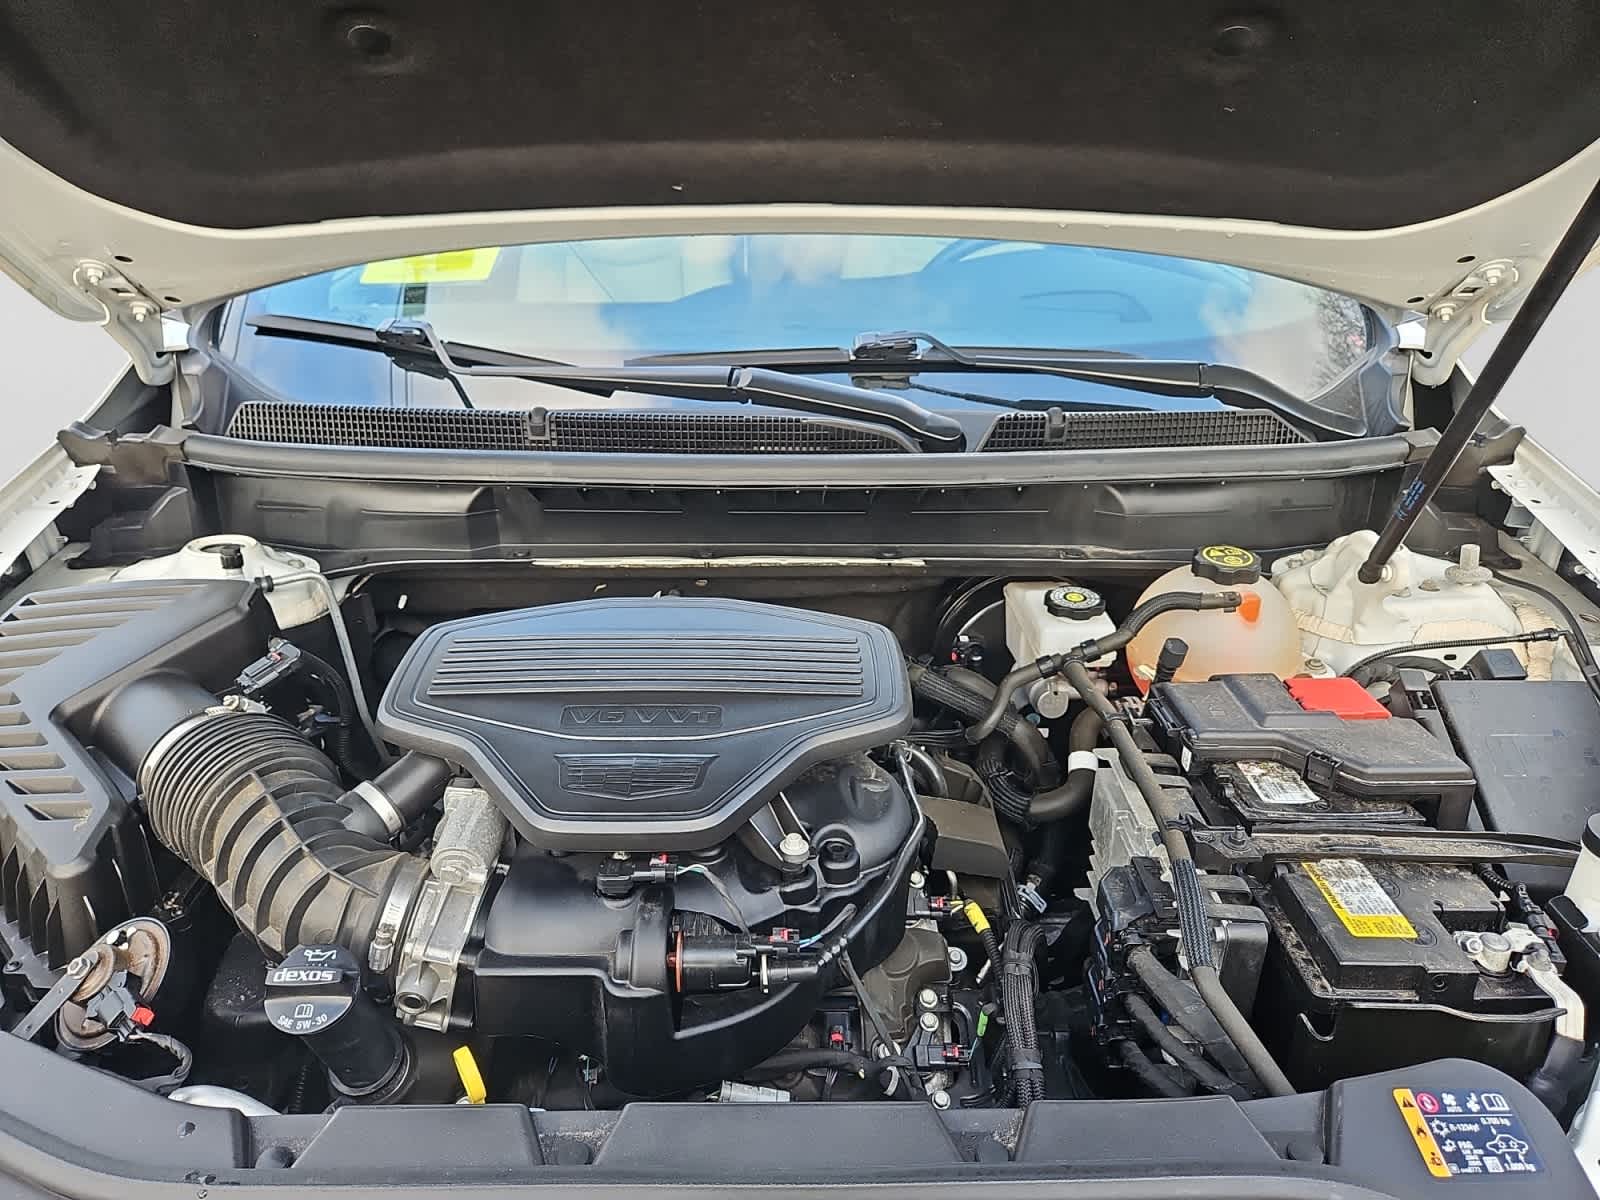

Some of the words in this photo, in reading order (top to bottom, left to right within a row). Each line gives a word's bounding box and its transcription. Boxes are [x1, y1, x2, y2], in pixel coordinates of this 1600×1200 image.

[568, 707, 626, 724] V6
[634, 707, 718, 724] VVT
[273, 967, 337, 983] dexos
[277, 1014, 294, 1029] SAE
[295, 1013, 329, 1030] 5W-30
